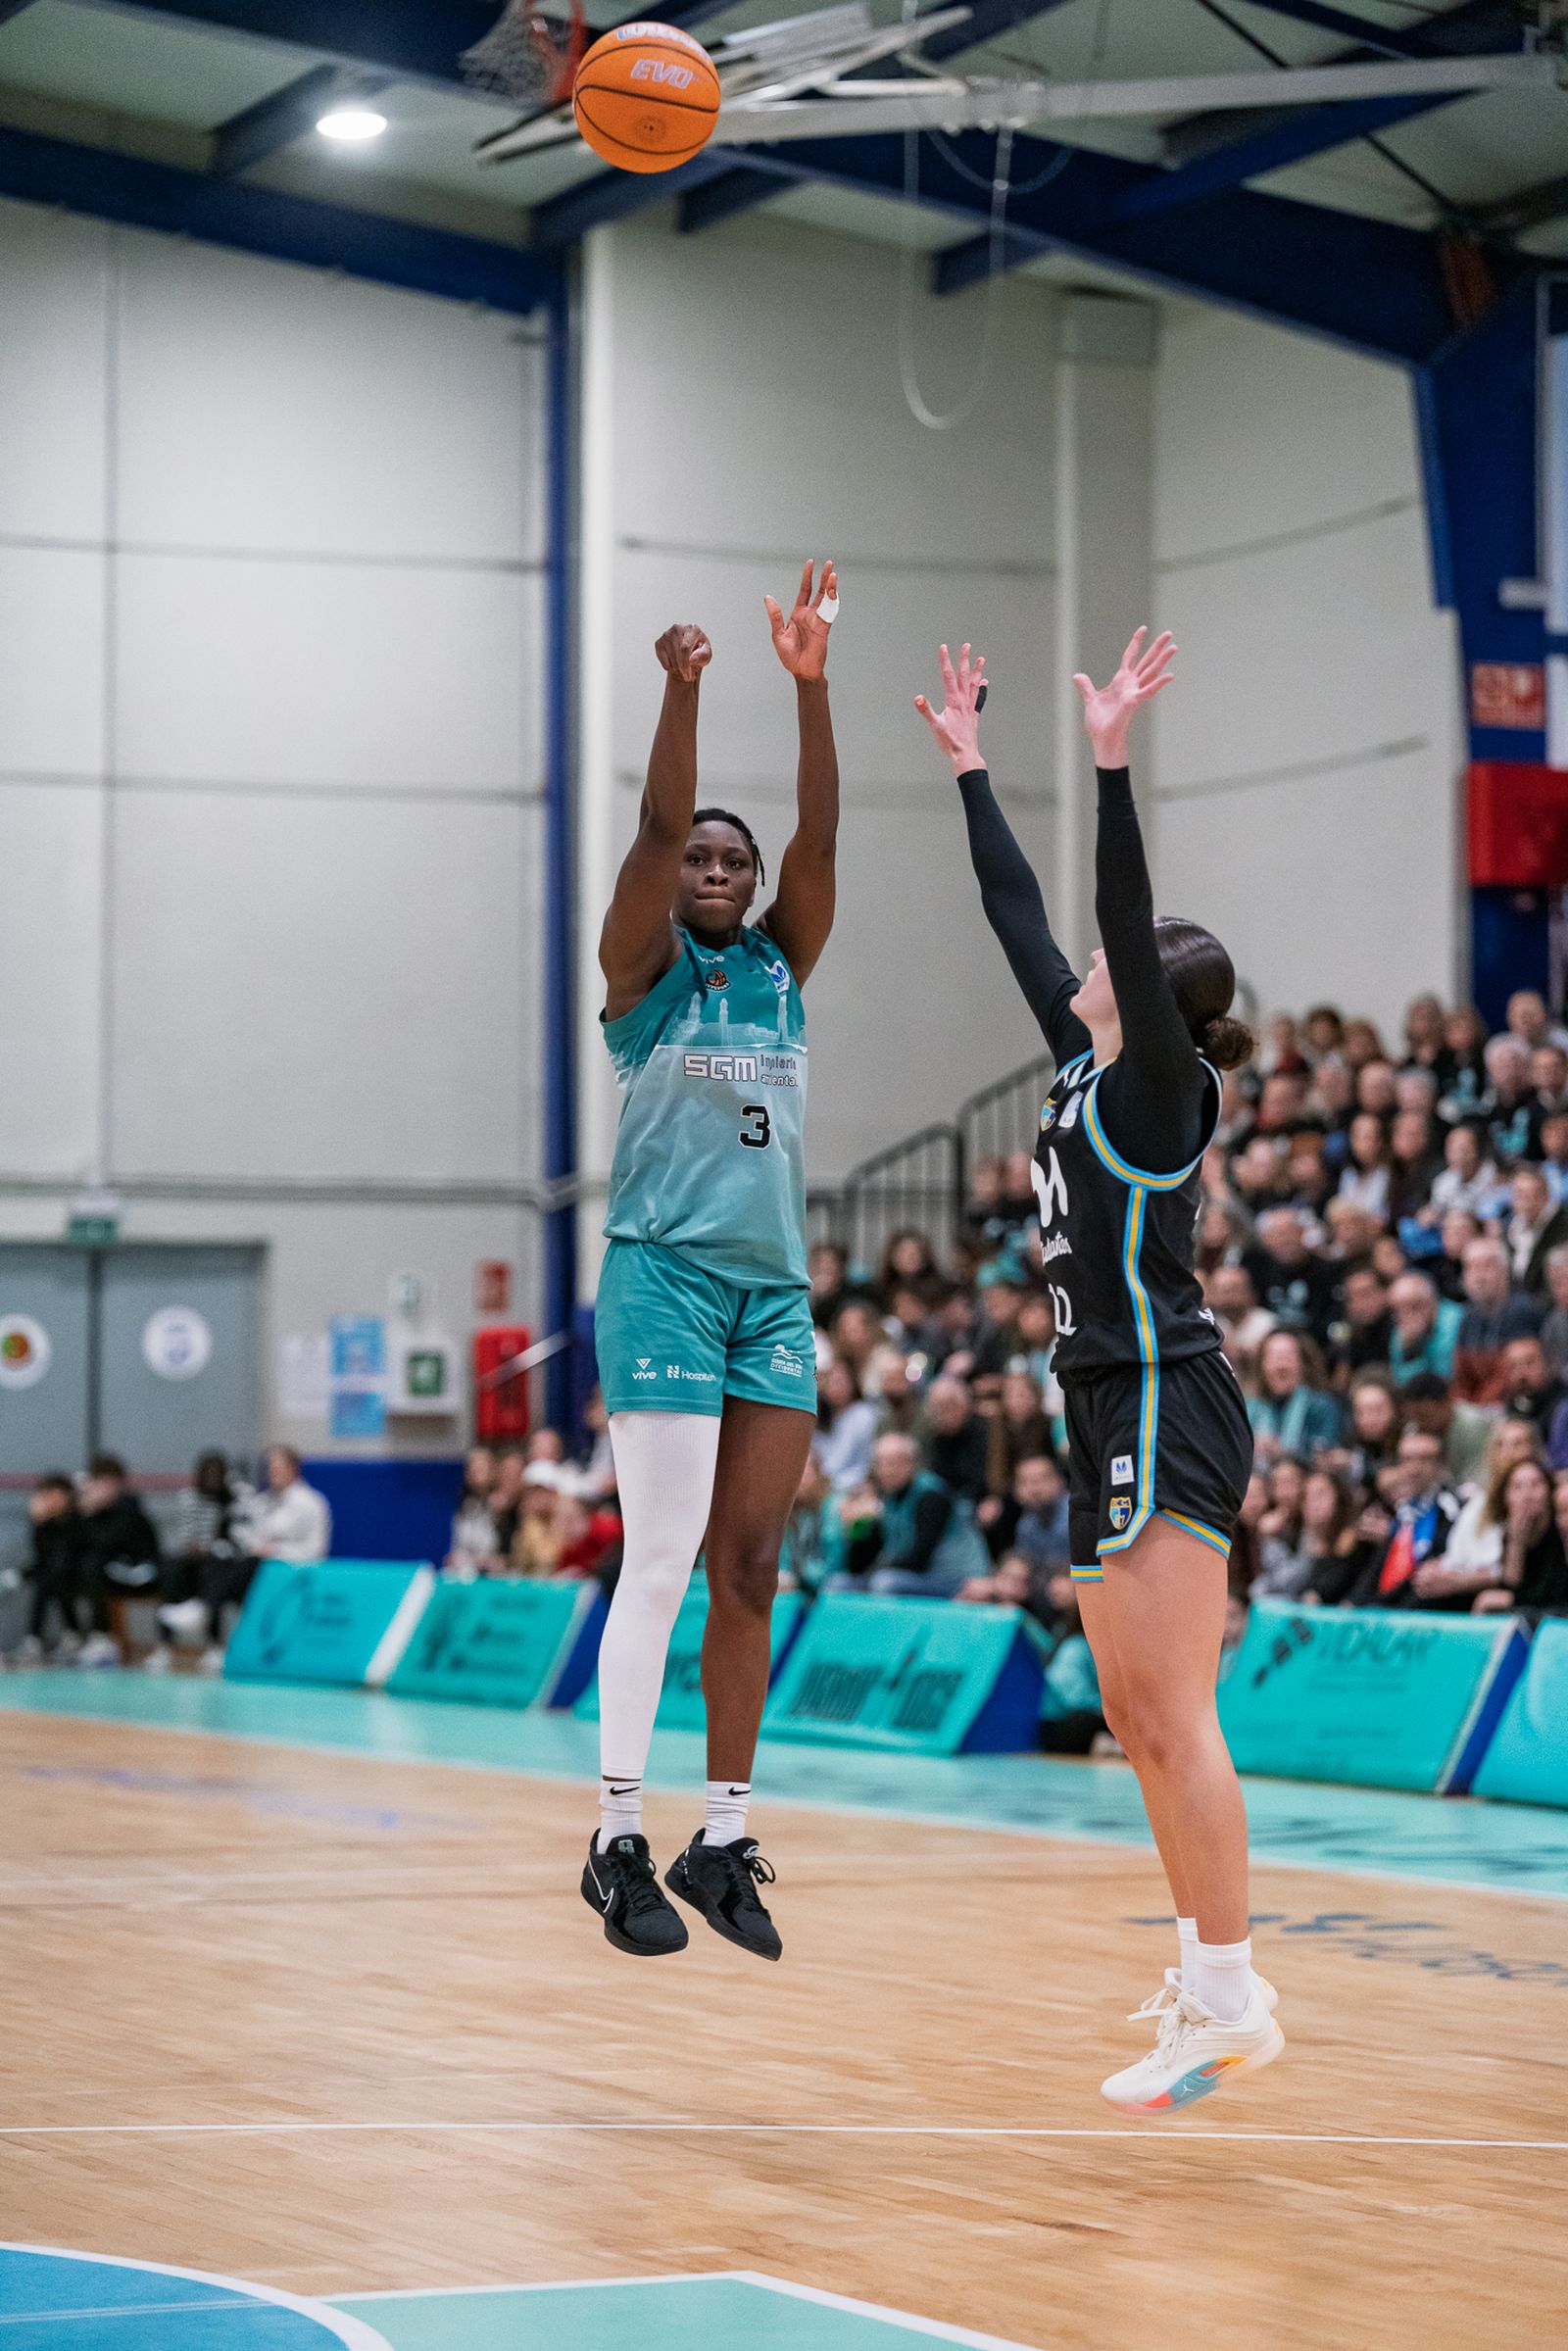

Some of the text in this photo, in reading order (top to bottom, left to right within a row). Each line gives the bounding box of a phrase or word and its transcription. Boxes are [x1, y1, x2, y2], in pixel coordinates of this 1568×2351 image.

[630, 59, 694, 89] EVO
[684, 1053, 758, 1082] SGM
[739, 1103, 771, 1151] 3
[632, 1370, 658, 1380] vive
